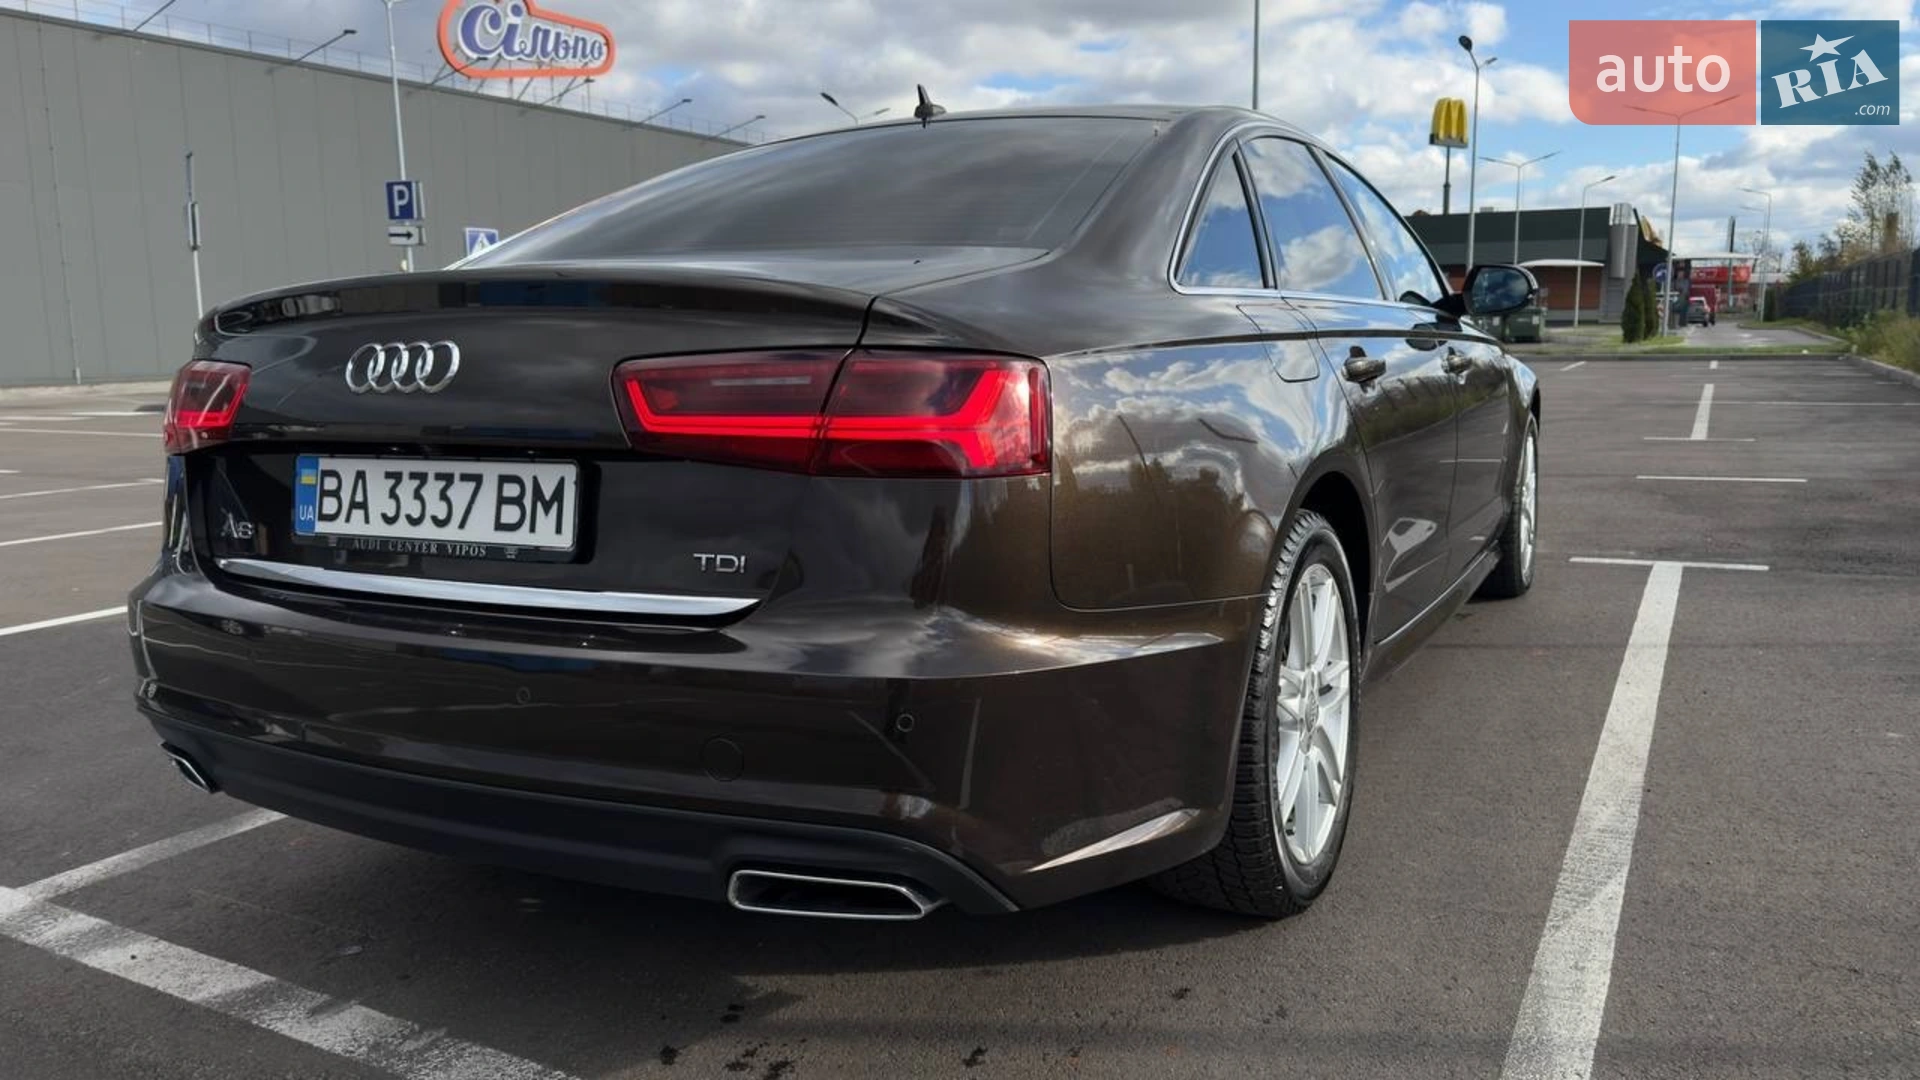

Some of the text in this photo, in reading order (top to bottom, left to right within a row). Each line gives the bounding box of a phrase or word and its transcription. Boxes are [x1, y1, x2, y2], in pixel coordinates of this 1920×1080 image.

[460, 3, 605, 60] Сільпо
[393, 184, 410, 217] P
[299, 504, 314, 521] UA
[316, 468, 566, 535] BA 3337 BM
[353, 537, 488, 557] AUDI CENTER VIPOS
[693, 552, 746, 574] TDI
